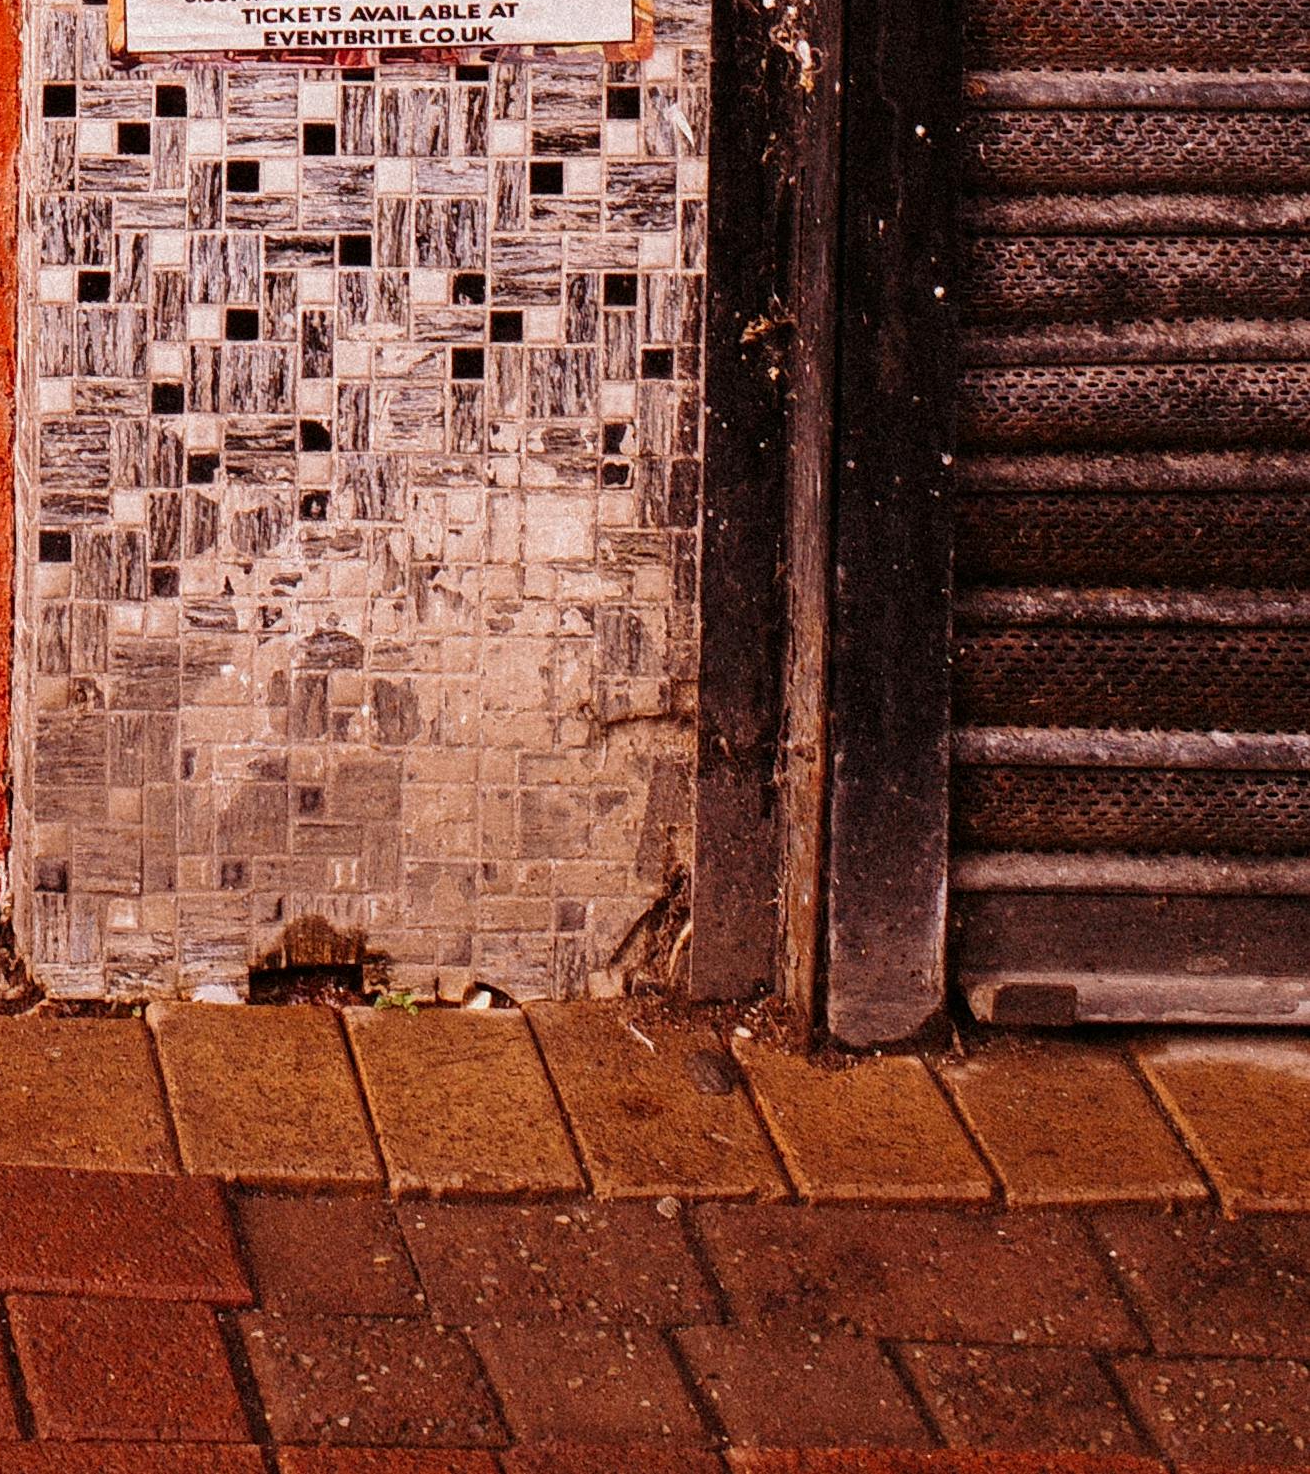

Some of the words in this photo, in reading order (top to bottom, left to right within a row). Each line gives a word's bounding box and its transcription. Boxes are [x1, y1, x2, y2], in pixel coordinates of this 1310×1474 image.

[241, 6, 342, 24] TICKETS
[349, 3, 481, 22] AVAILABLE
[488, 2, 519, 18] AT
[263, 26, 496, 47] EVENTBRITE.CO.UK
